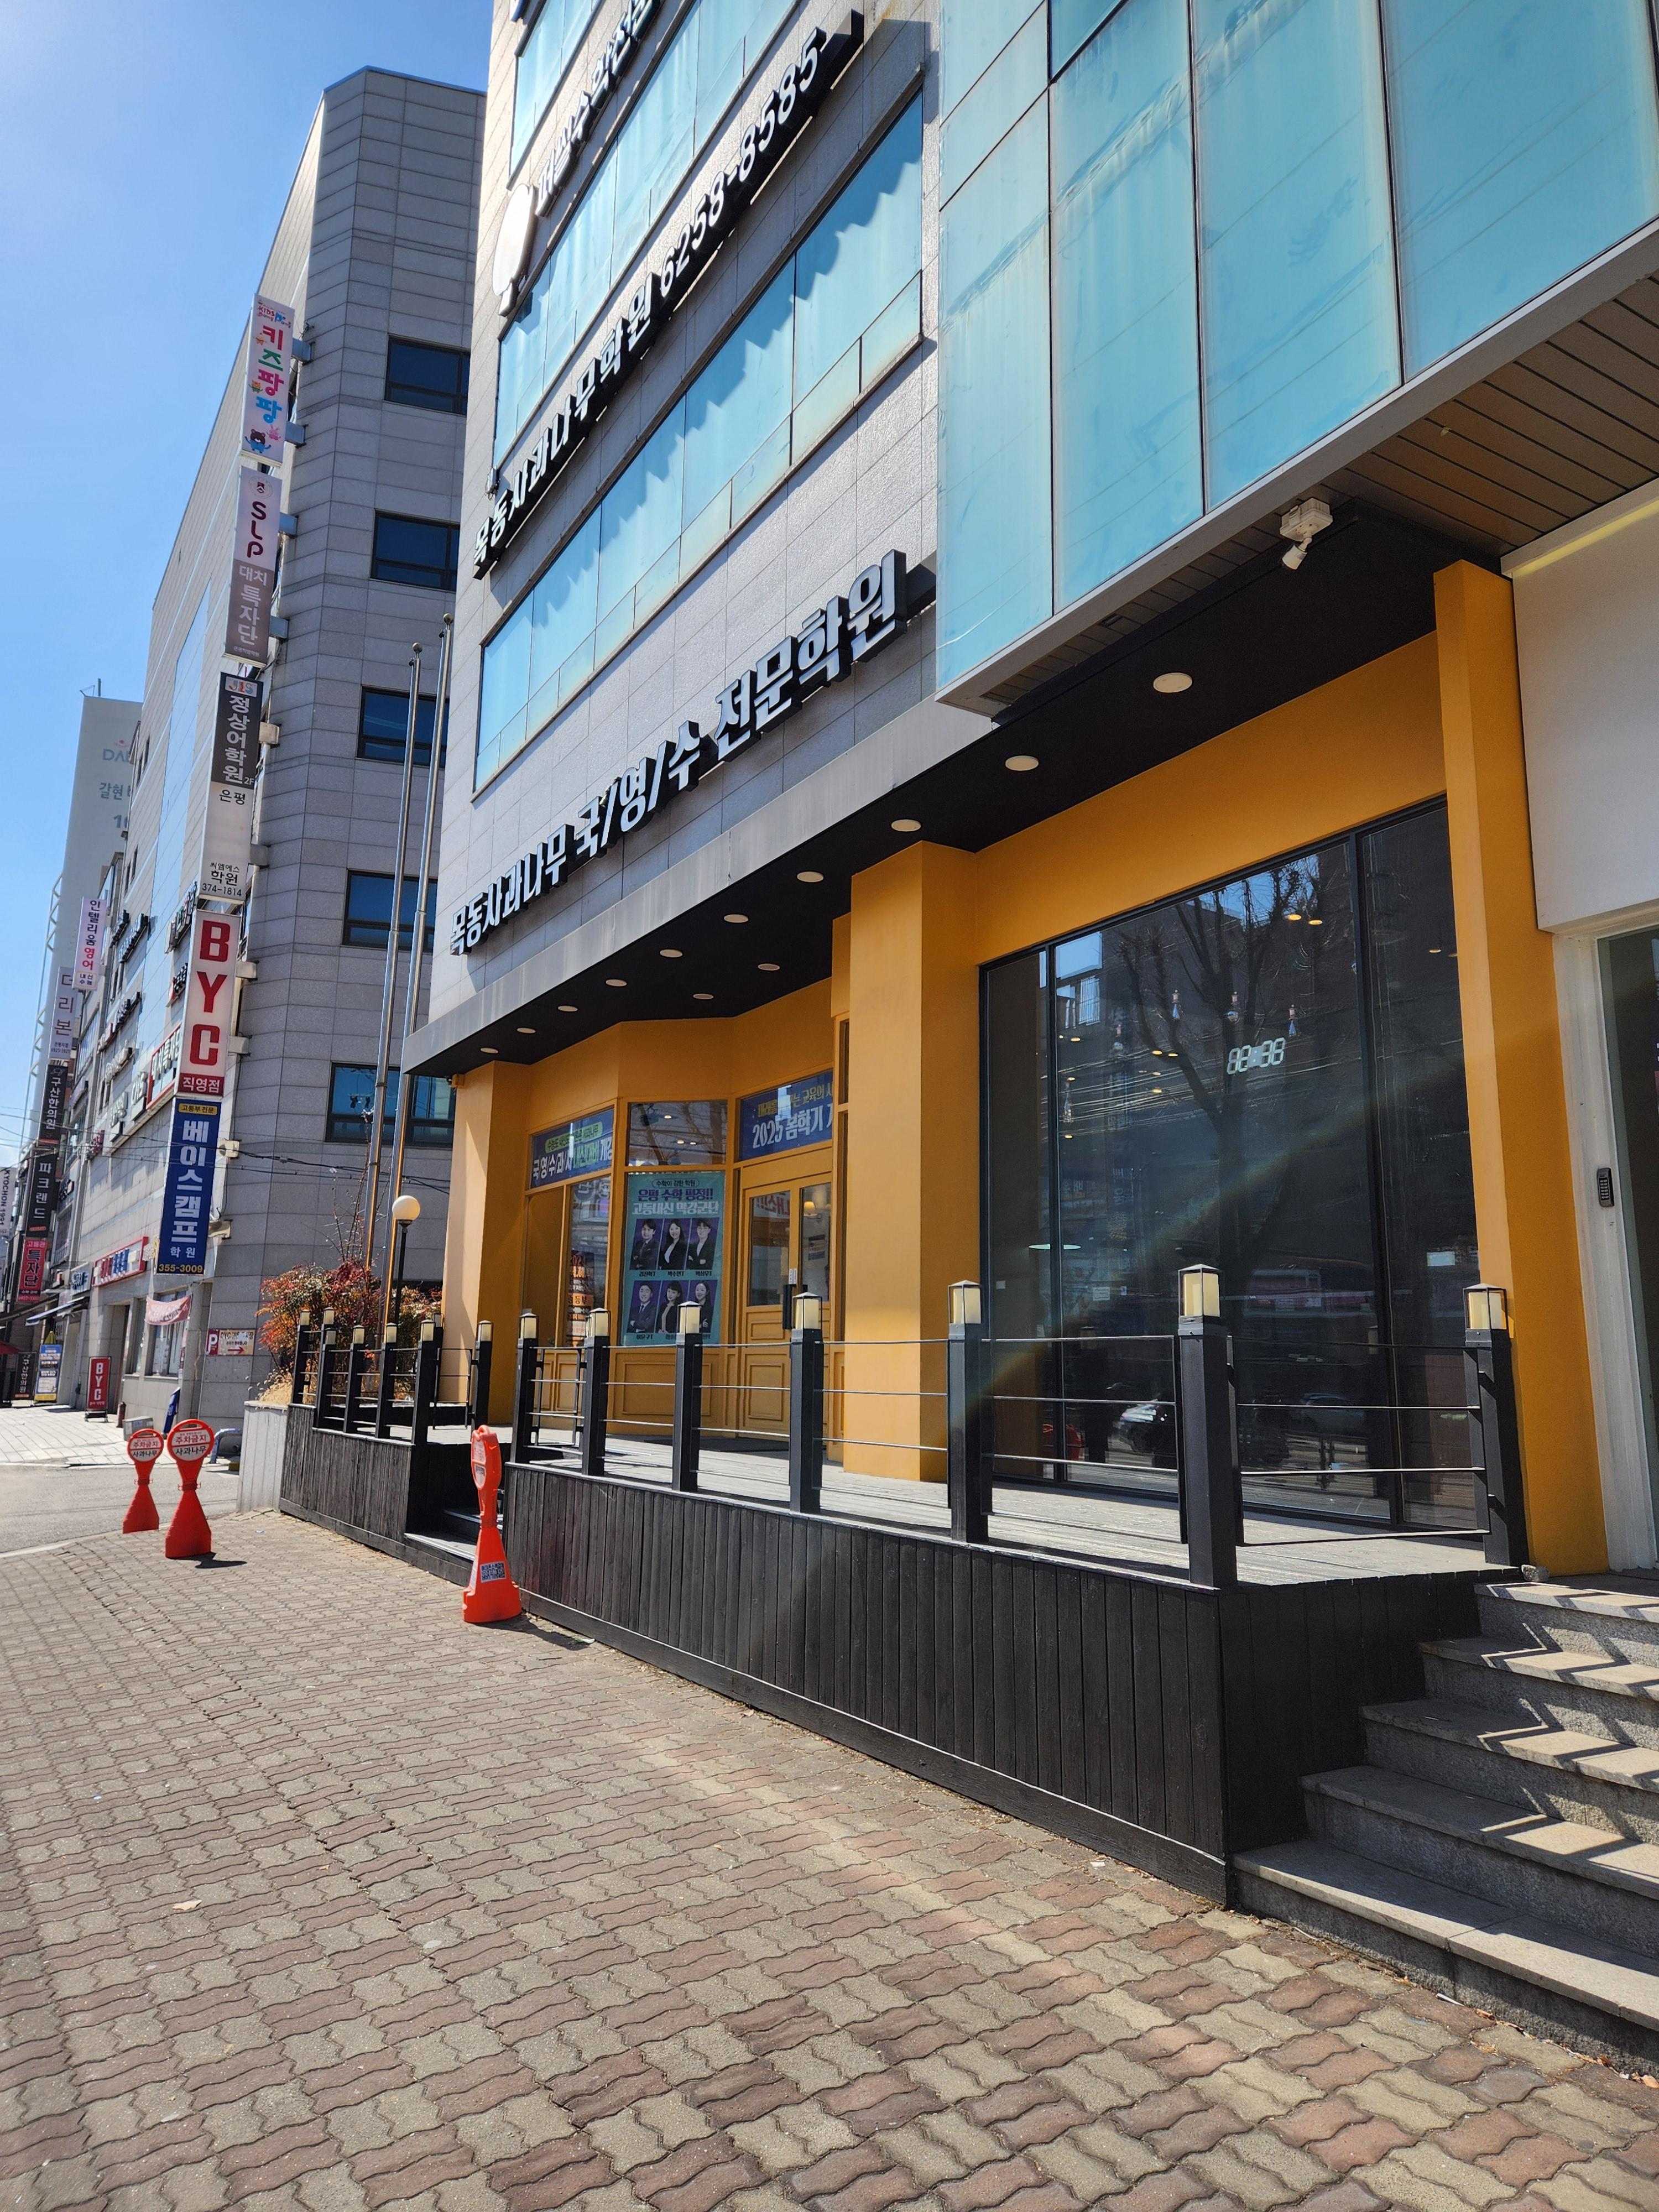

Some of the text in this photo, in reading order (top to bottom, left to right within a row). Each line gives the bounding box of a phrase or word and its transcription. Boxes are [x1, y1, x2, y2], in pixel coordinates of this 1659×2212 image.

[474, 28, 822, 575] 목동사과나무학원 6258-8585
[255, 325, 284, 425] 키즈팡팡
[247, 501, 267, 558] SLP
[238, 565, 267, 586] 대치
[237, 584, 262, 646] 특자단
[228, 678, 255, 695] JLS
[223, 694, 251, 785] 정상어학원
[451, 549, 905, 955] 목동사과나무 국/영/수 전문학원
[99, 782, 123, 800] 갈현
[244, 775, 254, 786] 2F
[219, 789, 246, 806] 은평
[210, 862, 240, 873] 씨엠에스
[210, 869, 238, 886] 학원
[201, 882, 243, 897] 374-1814
[189, 919, 231, 1067] BYC
[182, 1077, 220, 1094] 직영점
[46, 1077, 61, 1130] 구산한의원
[752, 1118, 784, 1149] 2025
[785, 1105, 823, 1140] 봄학기
[1, 1169, 11, 1207] KYOCHON
[33, 1162, 53, 1219] 파크랜드
[171, 1120, 210, 1243] 베이스캠프
[638, 1189, 659, 1202] 은평
[661, 1188, 683, 1201] 수학
[632, 1201, 719, 1215] 고등내신 막강군단
[170, 1246, 196, 1258] 학원
[24, 1248, 41, 1287] 특자단
[158, 1264, 203, 1273] 355-3009
[207, 1333, 218, 1354] P
[94, 1362, 103, 1401] BYC
[175, 1434, 207, 1444] 주차금지
[175, 1445, 207, 1456] 사과나무
